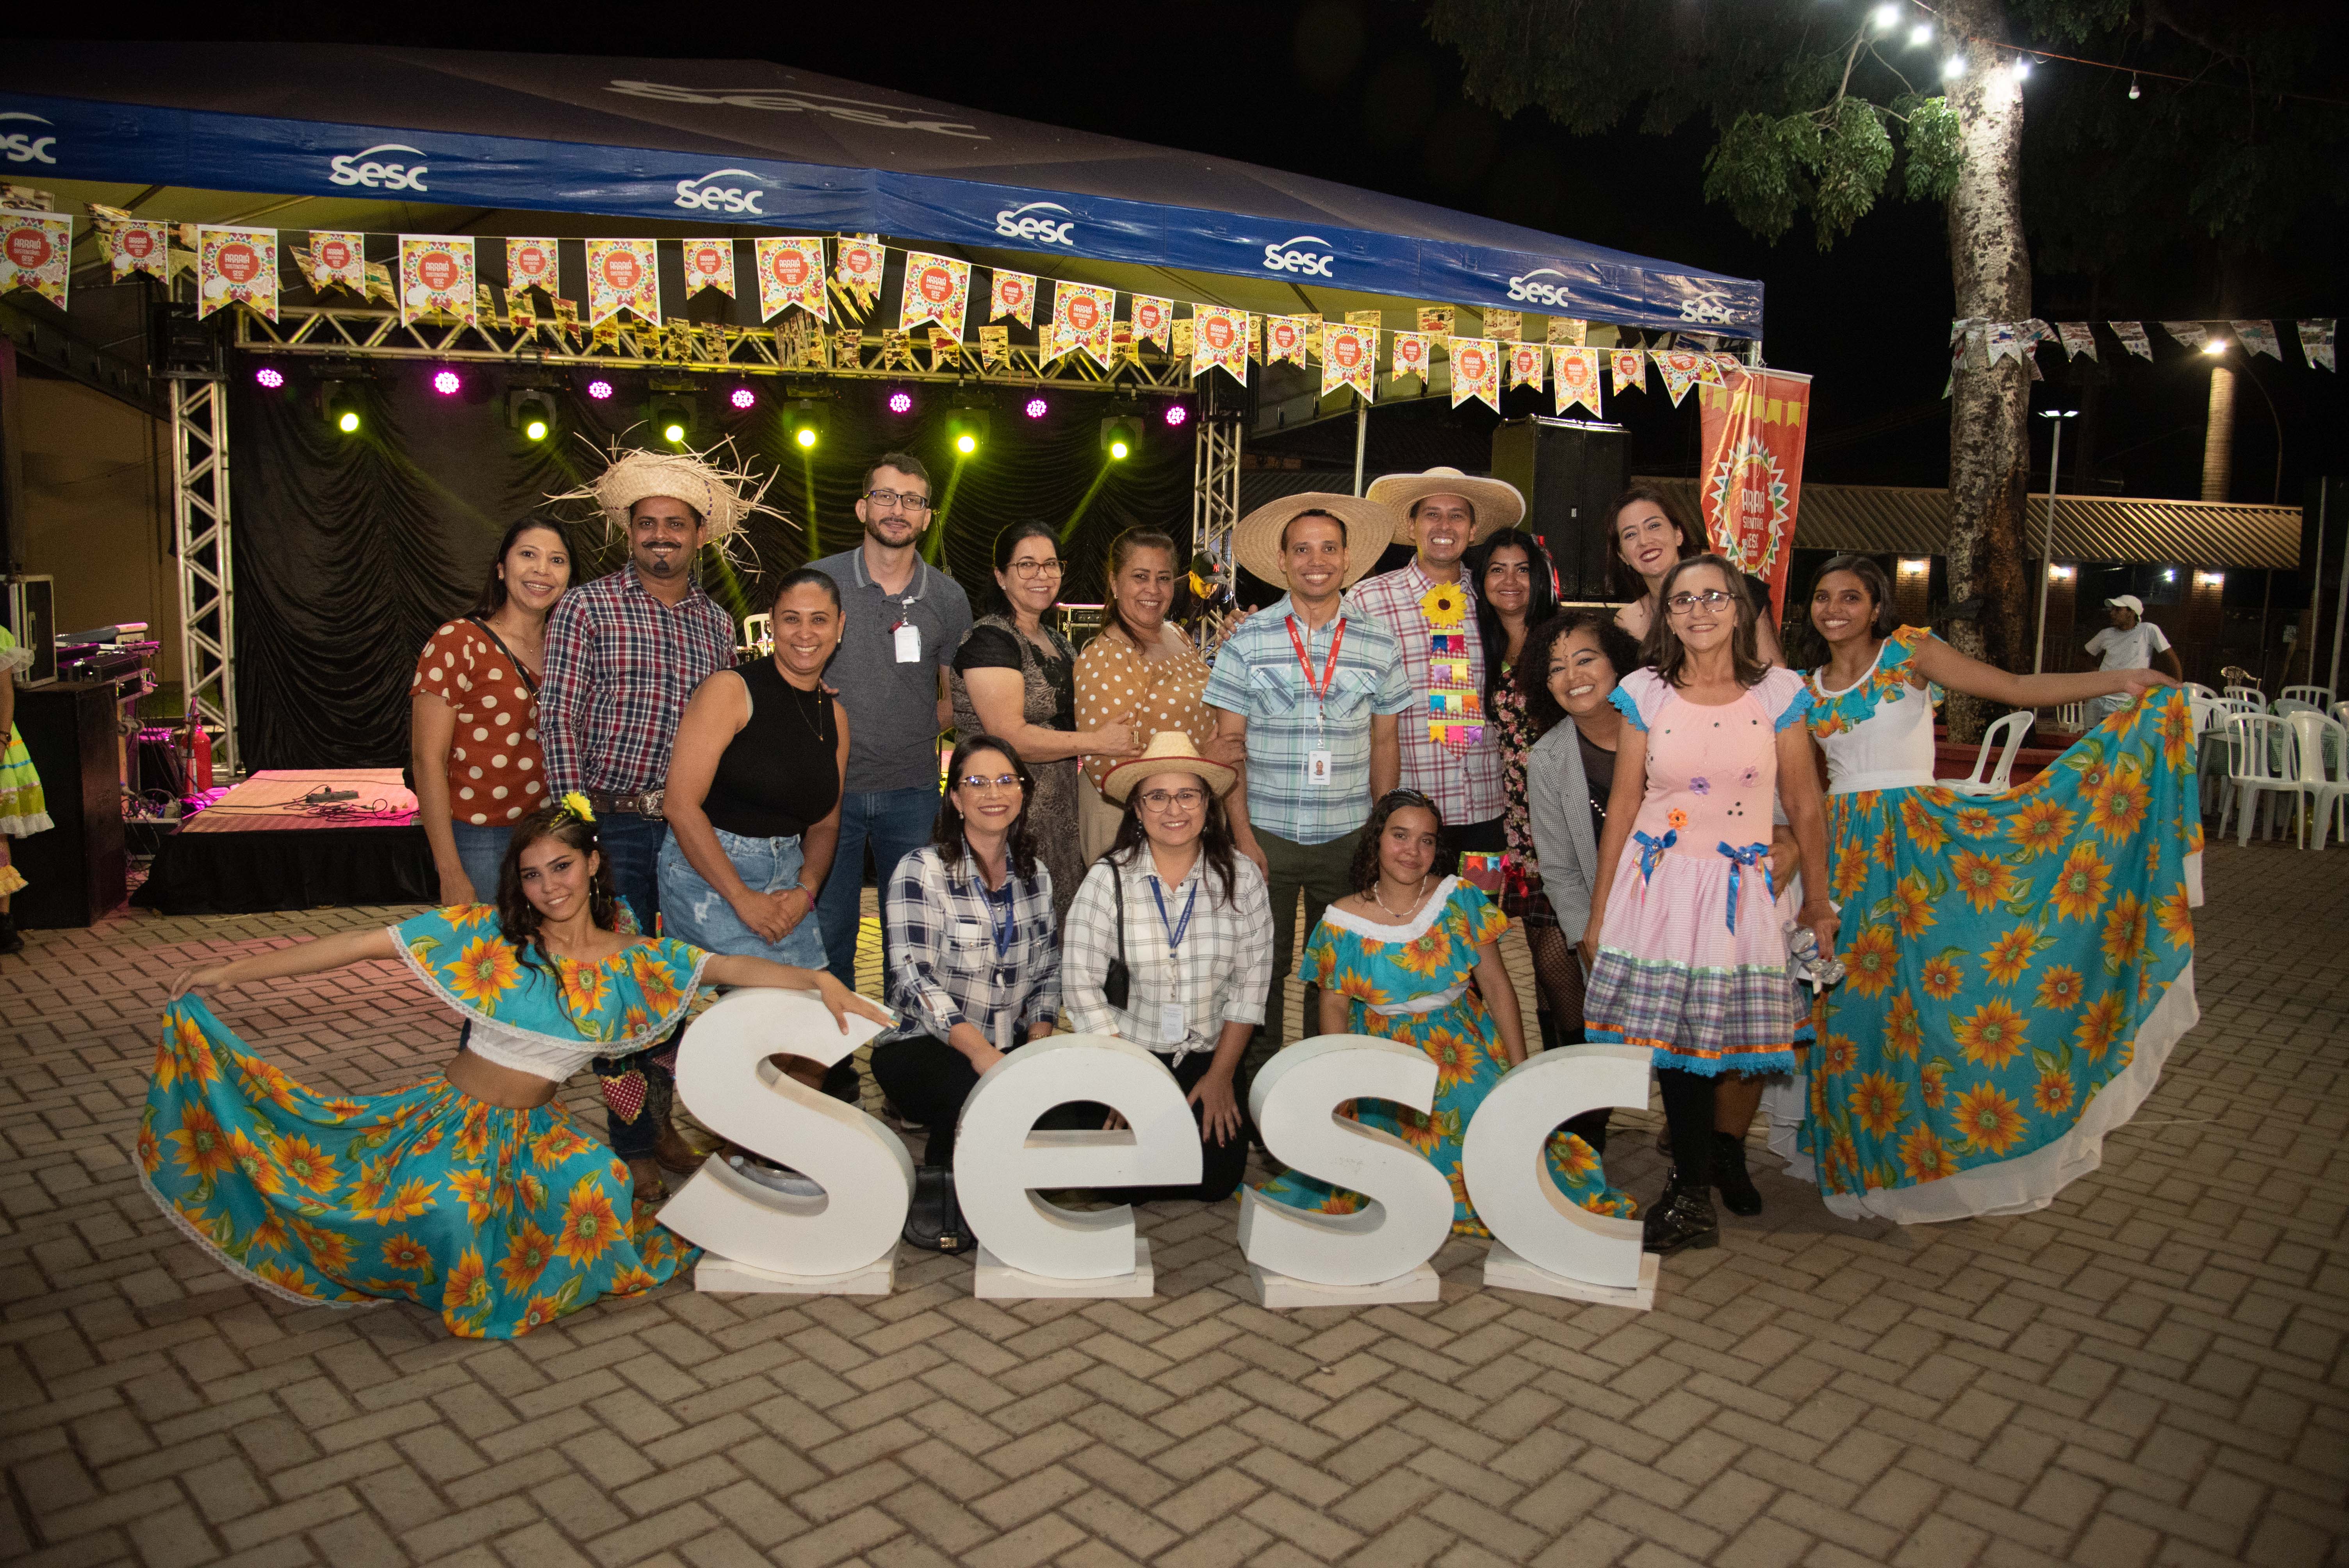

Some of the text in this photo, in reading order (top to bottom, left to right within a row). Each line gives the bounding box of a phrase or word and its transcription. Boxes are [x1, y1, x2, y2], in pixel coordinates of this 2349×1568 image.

[328, 155, 428, 191] Sesc
[674, 180, 763, 214] Sesc
[995, 211, 1074, 245] Sesc
[14, 238, 41, 249] ARRAIÁ
[225, 253, 250, 264] ARRAIÁ
[779, 258, 800, 268] ARRAIÁ
[1263, 244, 1333, 277] Sesc
[426, 261, 449, 271] ARRAIÁ
[610, 260, 632, 270] ARRAIÁ
[927, 275, 946, 286] ARRAIÁ
[1507, 276, 1568, 307] Sesc
[1074, 304, 1092, 314] ARRAIÁ
[1680, 299, 1735, 325] Sesc
[1210, 324, 1228, 333] ARRAIÁ
[1339, 343, 1356, 351] ARRAIÁ
[1464, 356, 1480, 365] ARRAIÁ
[657, 989, 1653, 1288] Sesc
